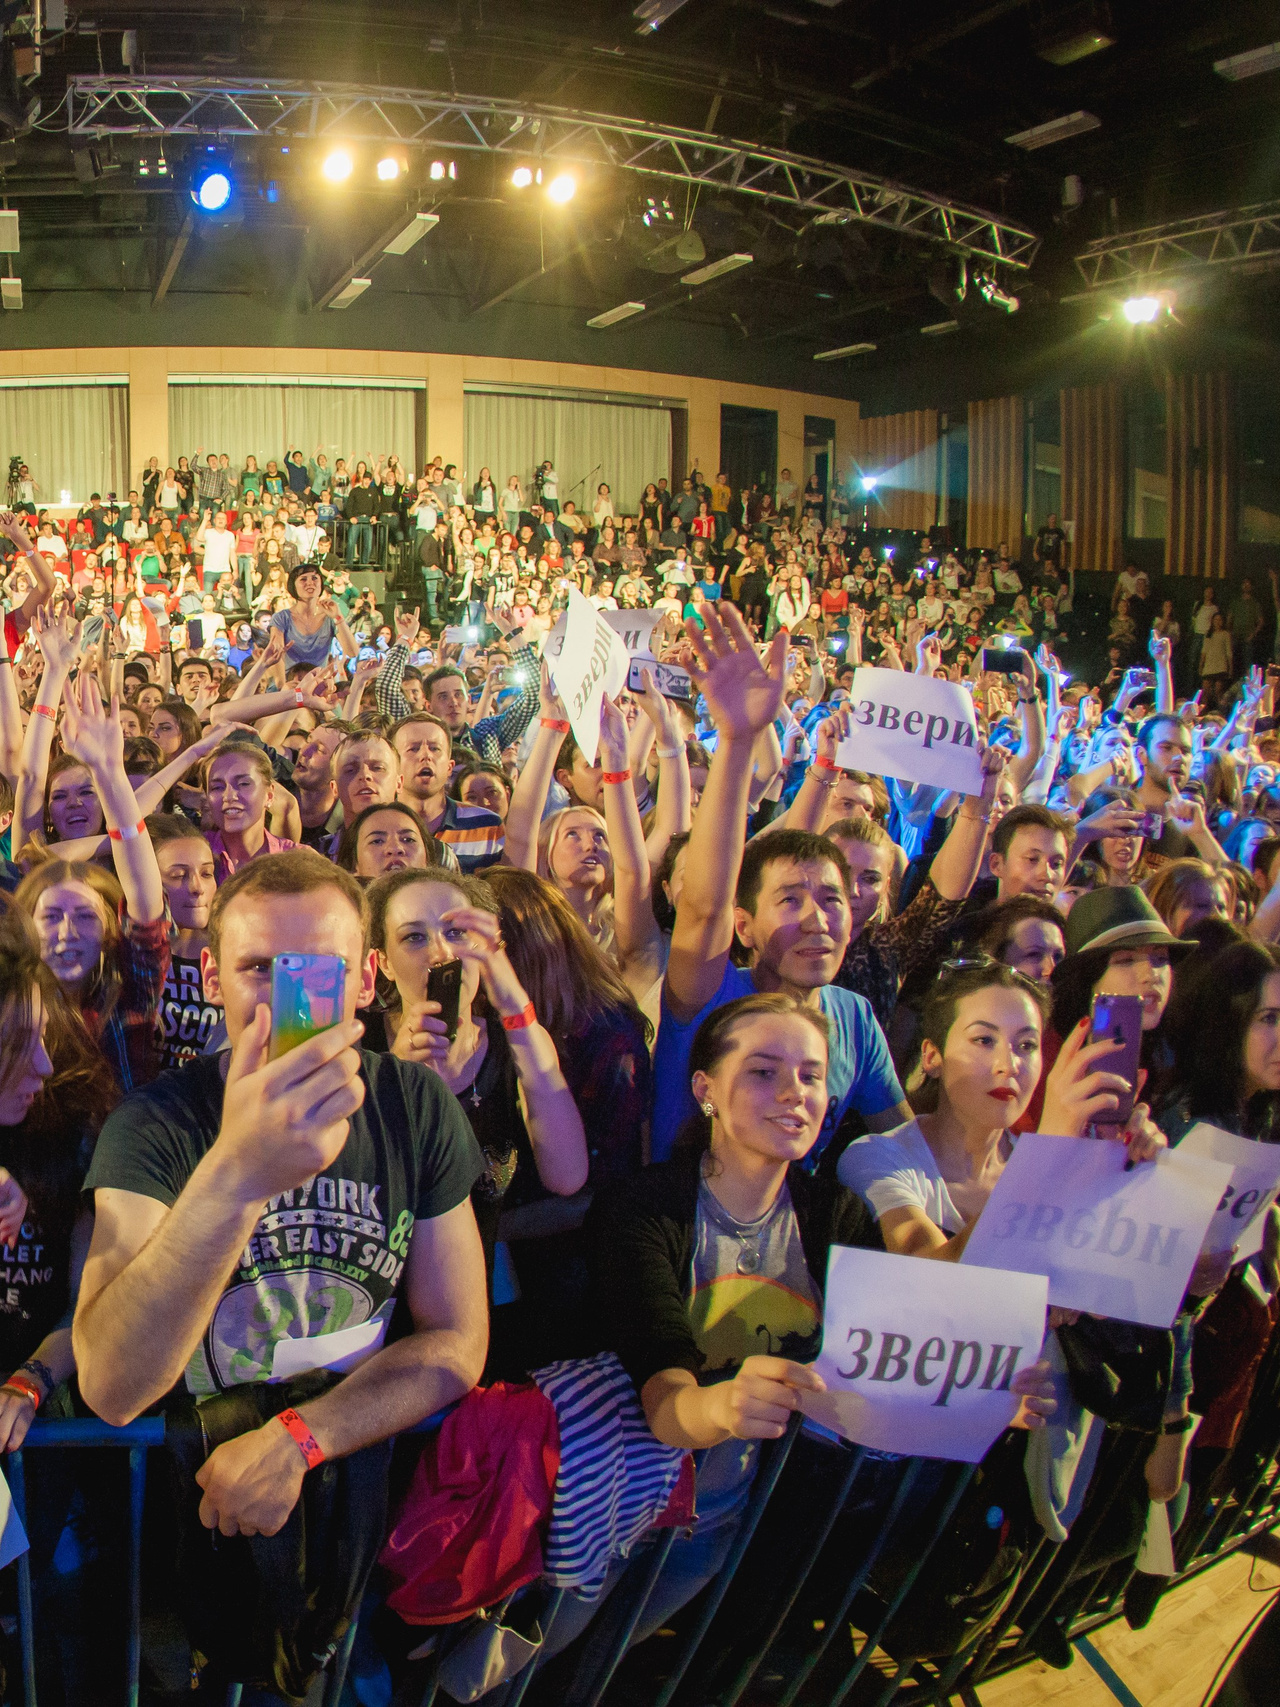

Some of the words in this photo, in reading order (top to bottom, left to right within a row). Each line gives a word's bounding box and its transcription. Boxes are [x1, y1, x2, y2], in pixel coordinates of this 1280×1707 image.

[572, 620, 612, 721] звери
[855, 699, 975, 750] звери
[2, 1243, 45, 1264] LET
[284, 1226, 358, 1260] EAST
[835, 1326, 1024, 1408] звери
